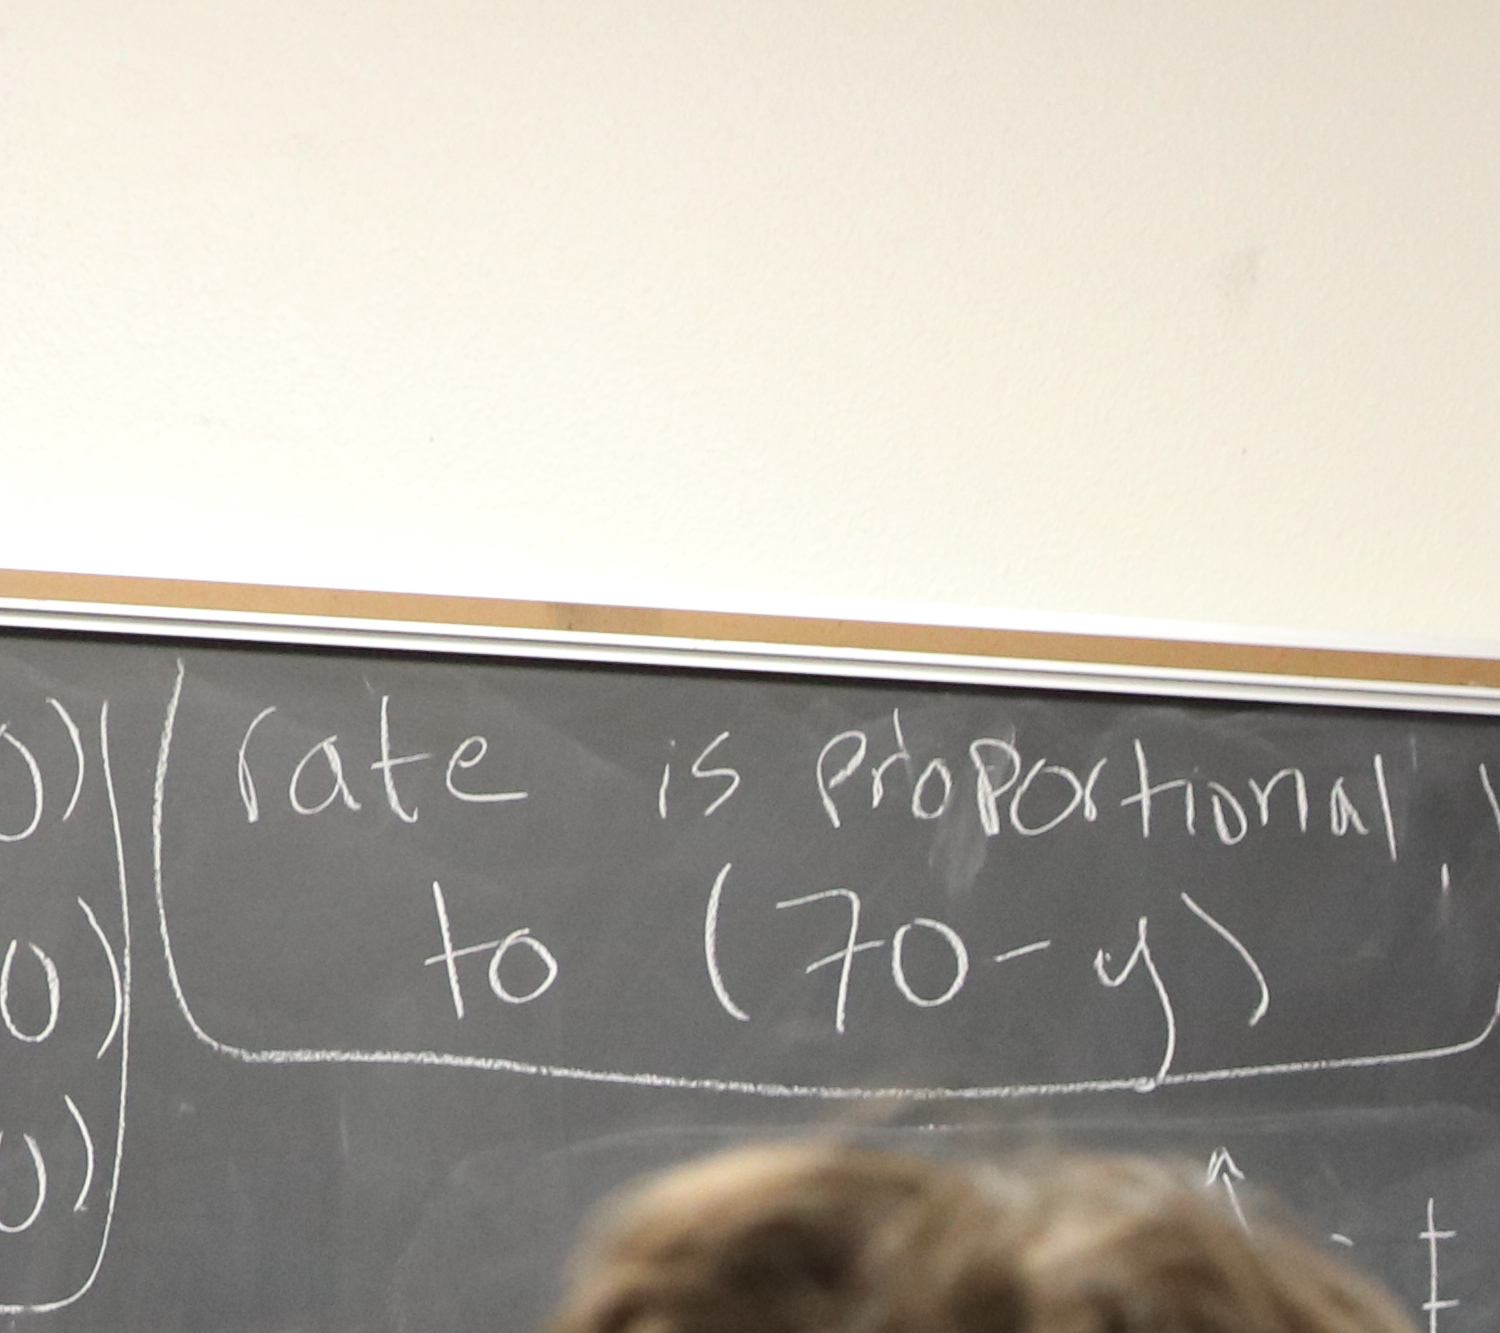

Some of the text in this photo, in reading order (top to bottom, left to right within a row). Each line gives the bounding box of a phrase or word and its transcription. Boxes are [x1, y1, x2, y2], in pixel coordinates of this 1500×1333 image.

[235, 695, 530, 824] rate
[658, 728, 741, 820] is
[424, 880, 558, 1020] to
